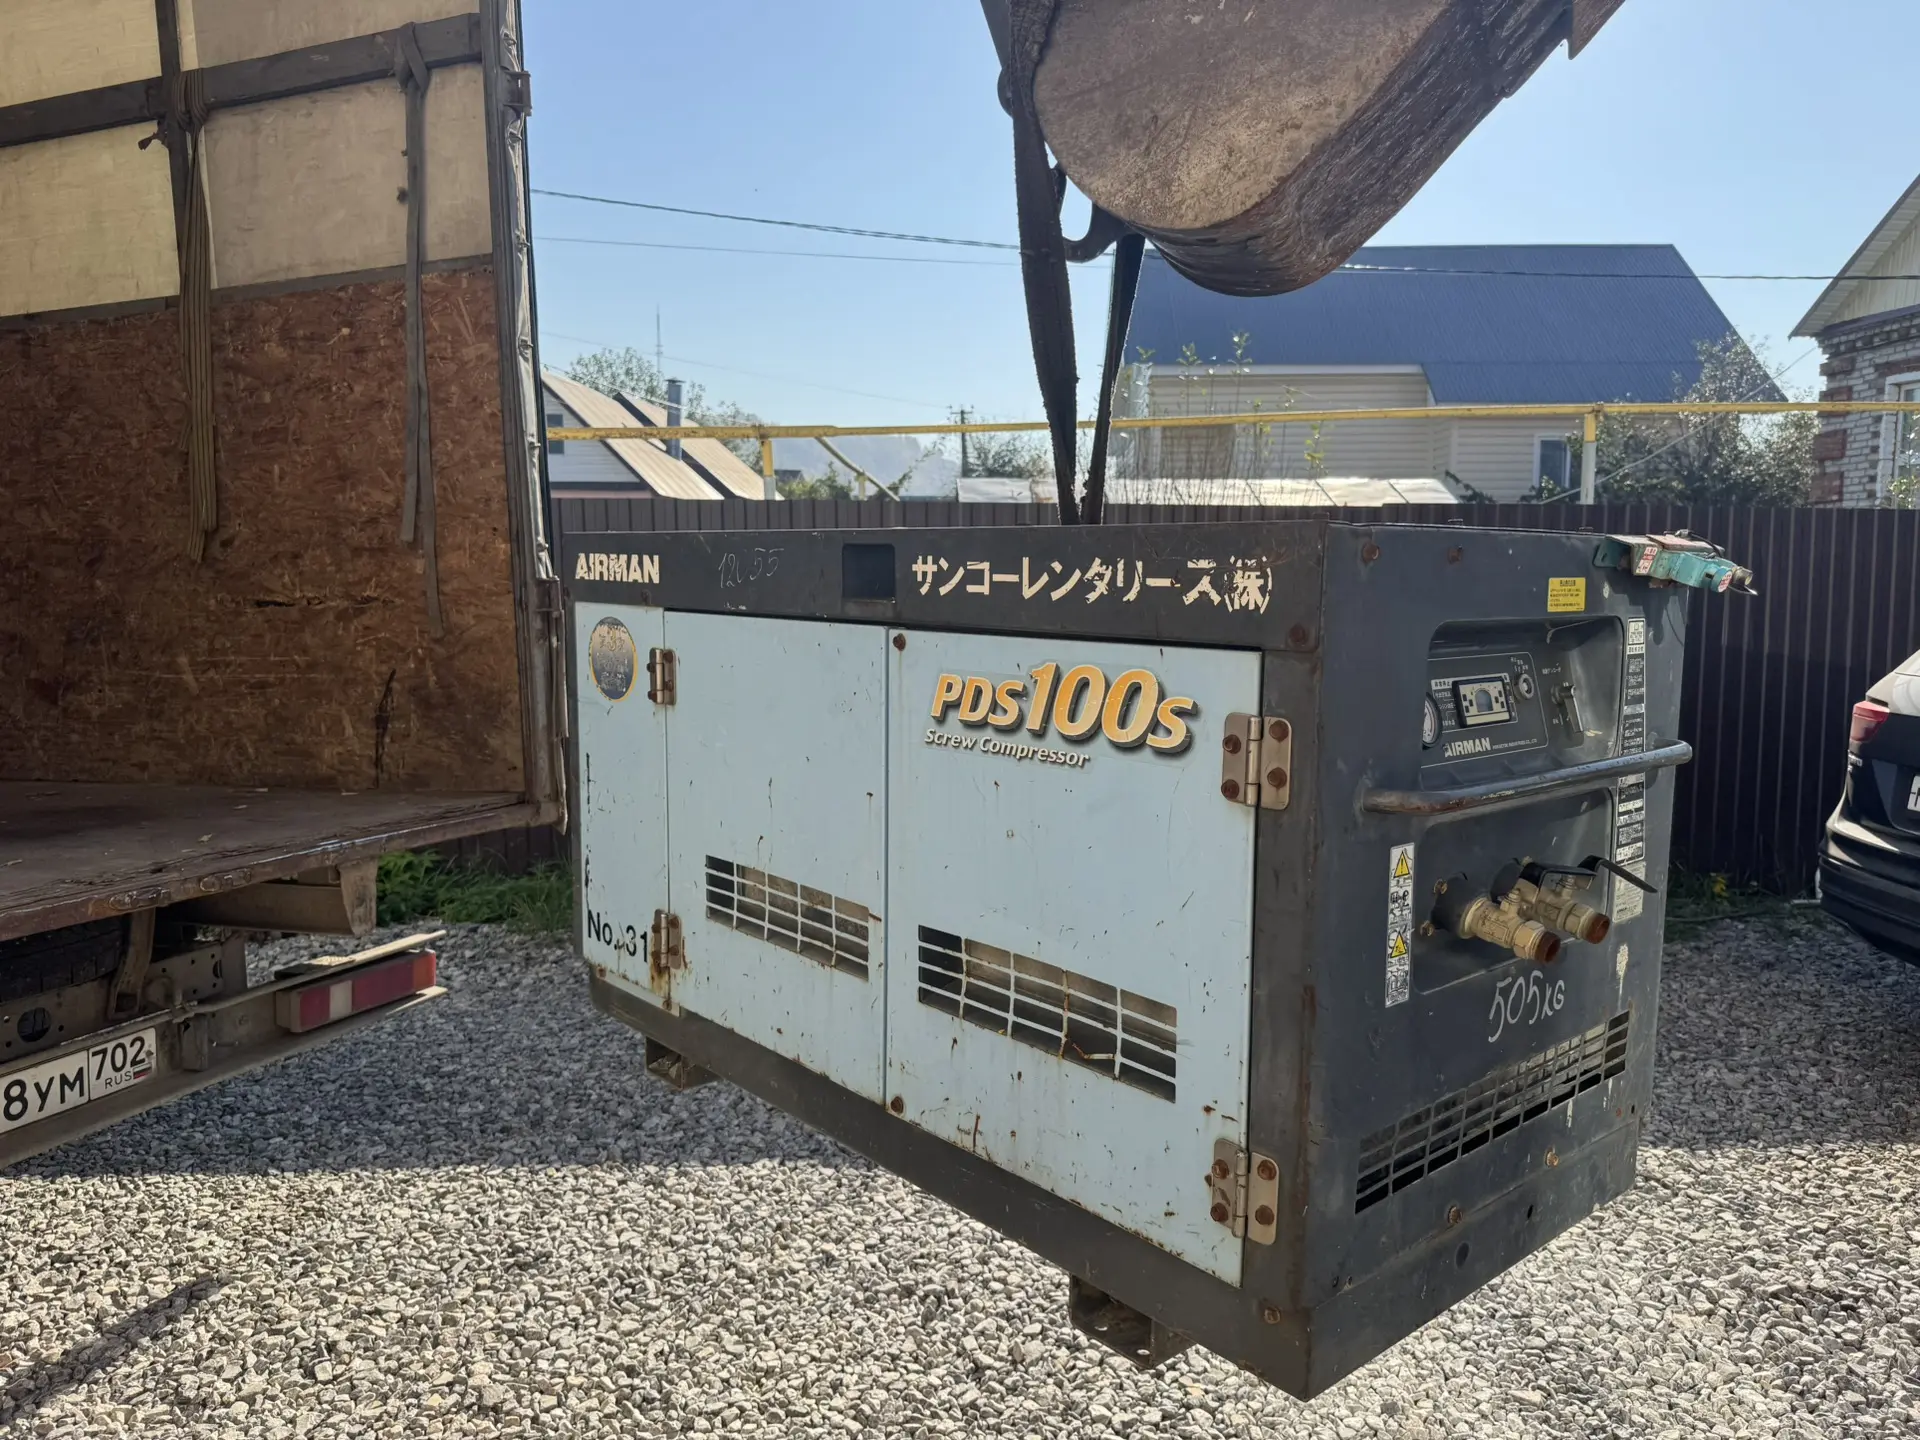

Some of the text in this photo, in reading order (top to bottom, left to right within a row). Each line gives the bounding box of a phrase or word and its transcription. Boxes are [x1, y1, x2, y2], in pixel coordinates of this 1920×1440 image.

[575, 553, 660, 584] AIRMAN
[924, 728, 1090, 769] Screw Compressor
[1443, 737, 1491, 757] AIRMAN
[91, 1036, 146, 1081] 702
[105, 1071, 132, 1090] RUS
